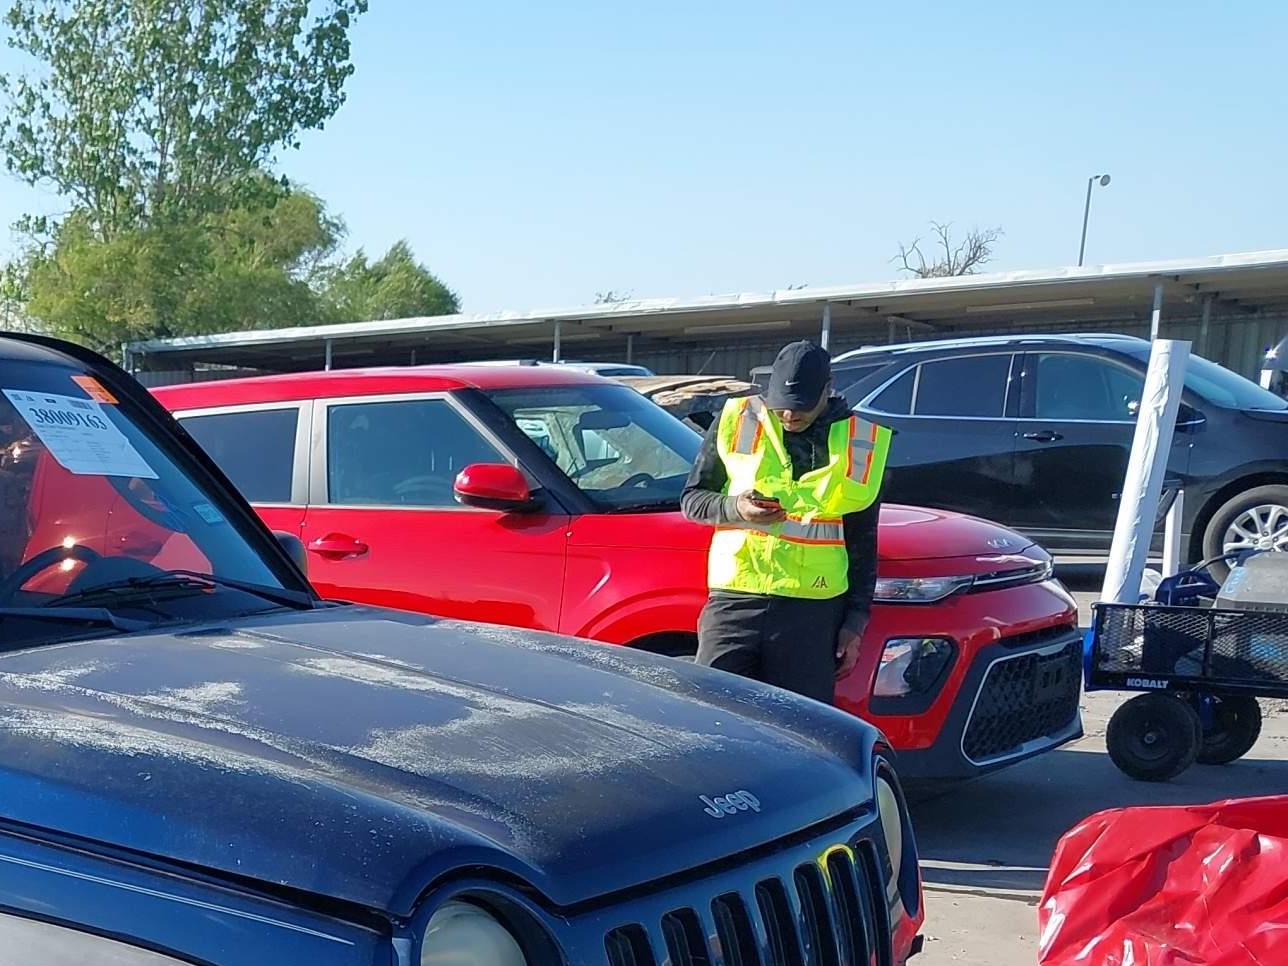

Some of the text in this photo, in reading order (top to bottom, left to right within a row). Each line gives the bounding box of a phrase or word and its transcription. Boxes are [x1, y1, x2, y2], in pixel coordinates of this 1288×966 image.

[29, 408, 108, 430] 38009163
[1127, 678, 1169, 689] KOBALT
[699, 790, 760, 818] Jeep
